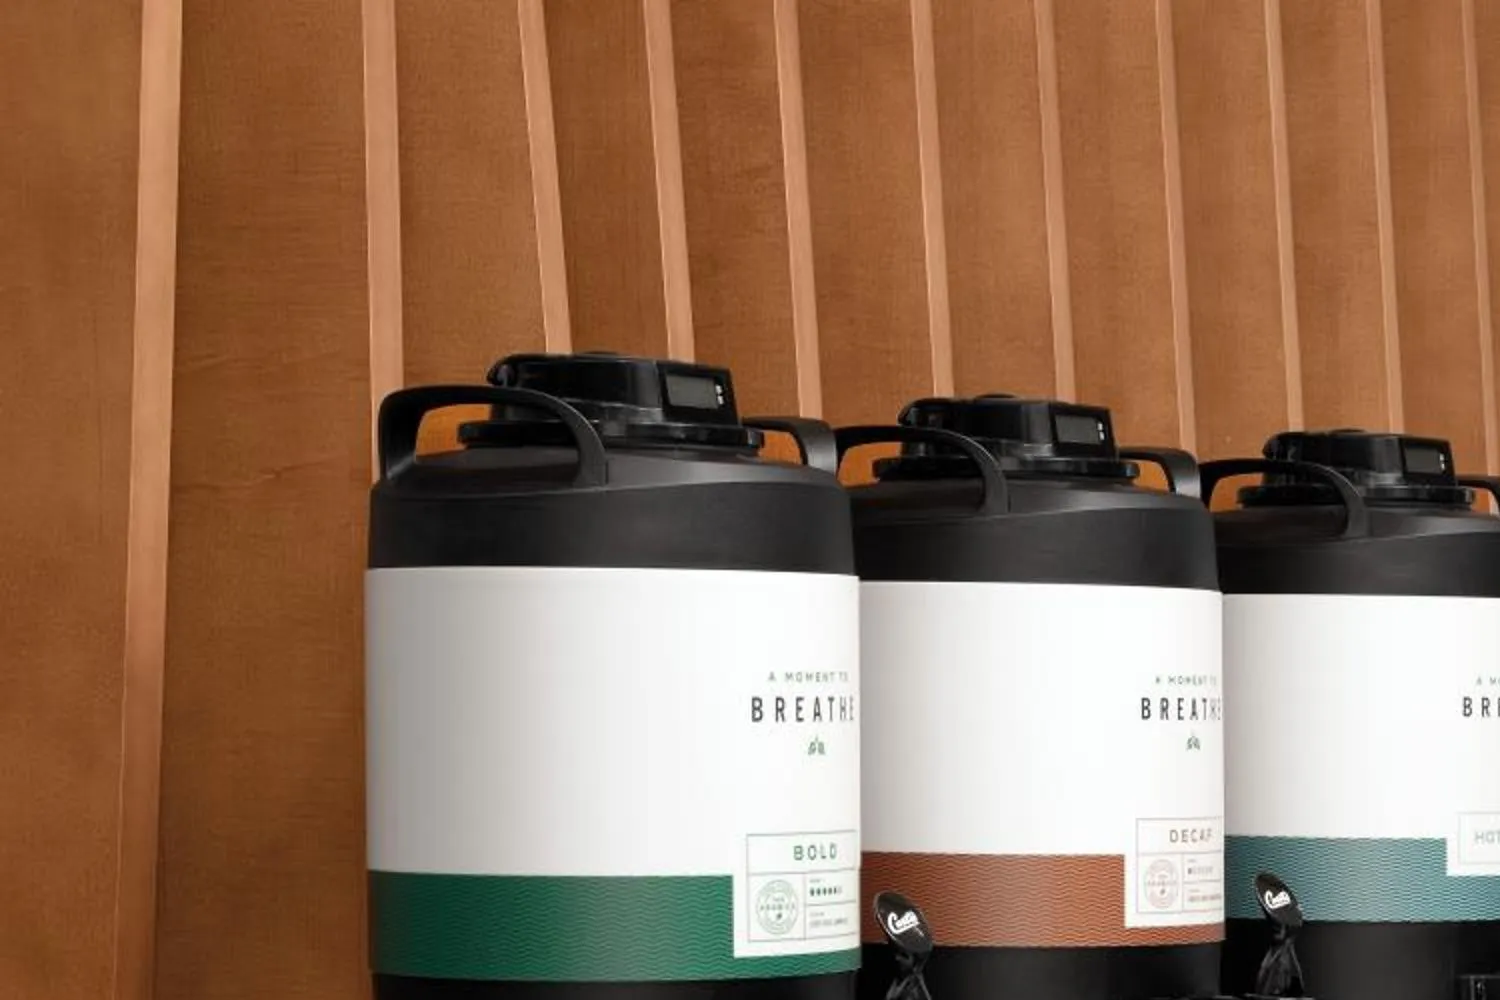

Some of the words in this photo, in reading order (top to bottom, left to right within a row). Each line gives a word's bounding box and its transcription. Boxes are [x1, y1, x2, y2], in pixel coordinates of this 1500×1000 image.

[768, 671, 777, 682] A
[785, 671, 836, 683] MOMENT
[1168, 674, 1207, 687] MOMENT
[751, 695, 855, 723] BREATHE
[1169, 827, 1213, 844] DECAF
[793, 843, 838, 861] BOLD
